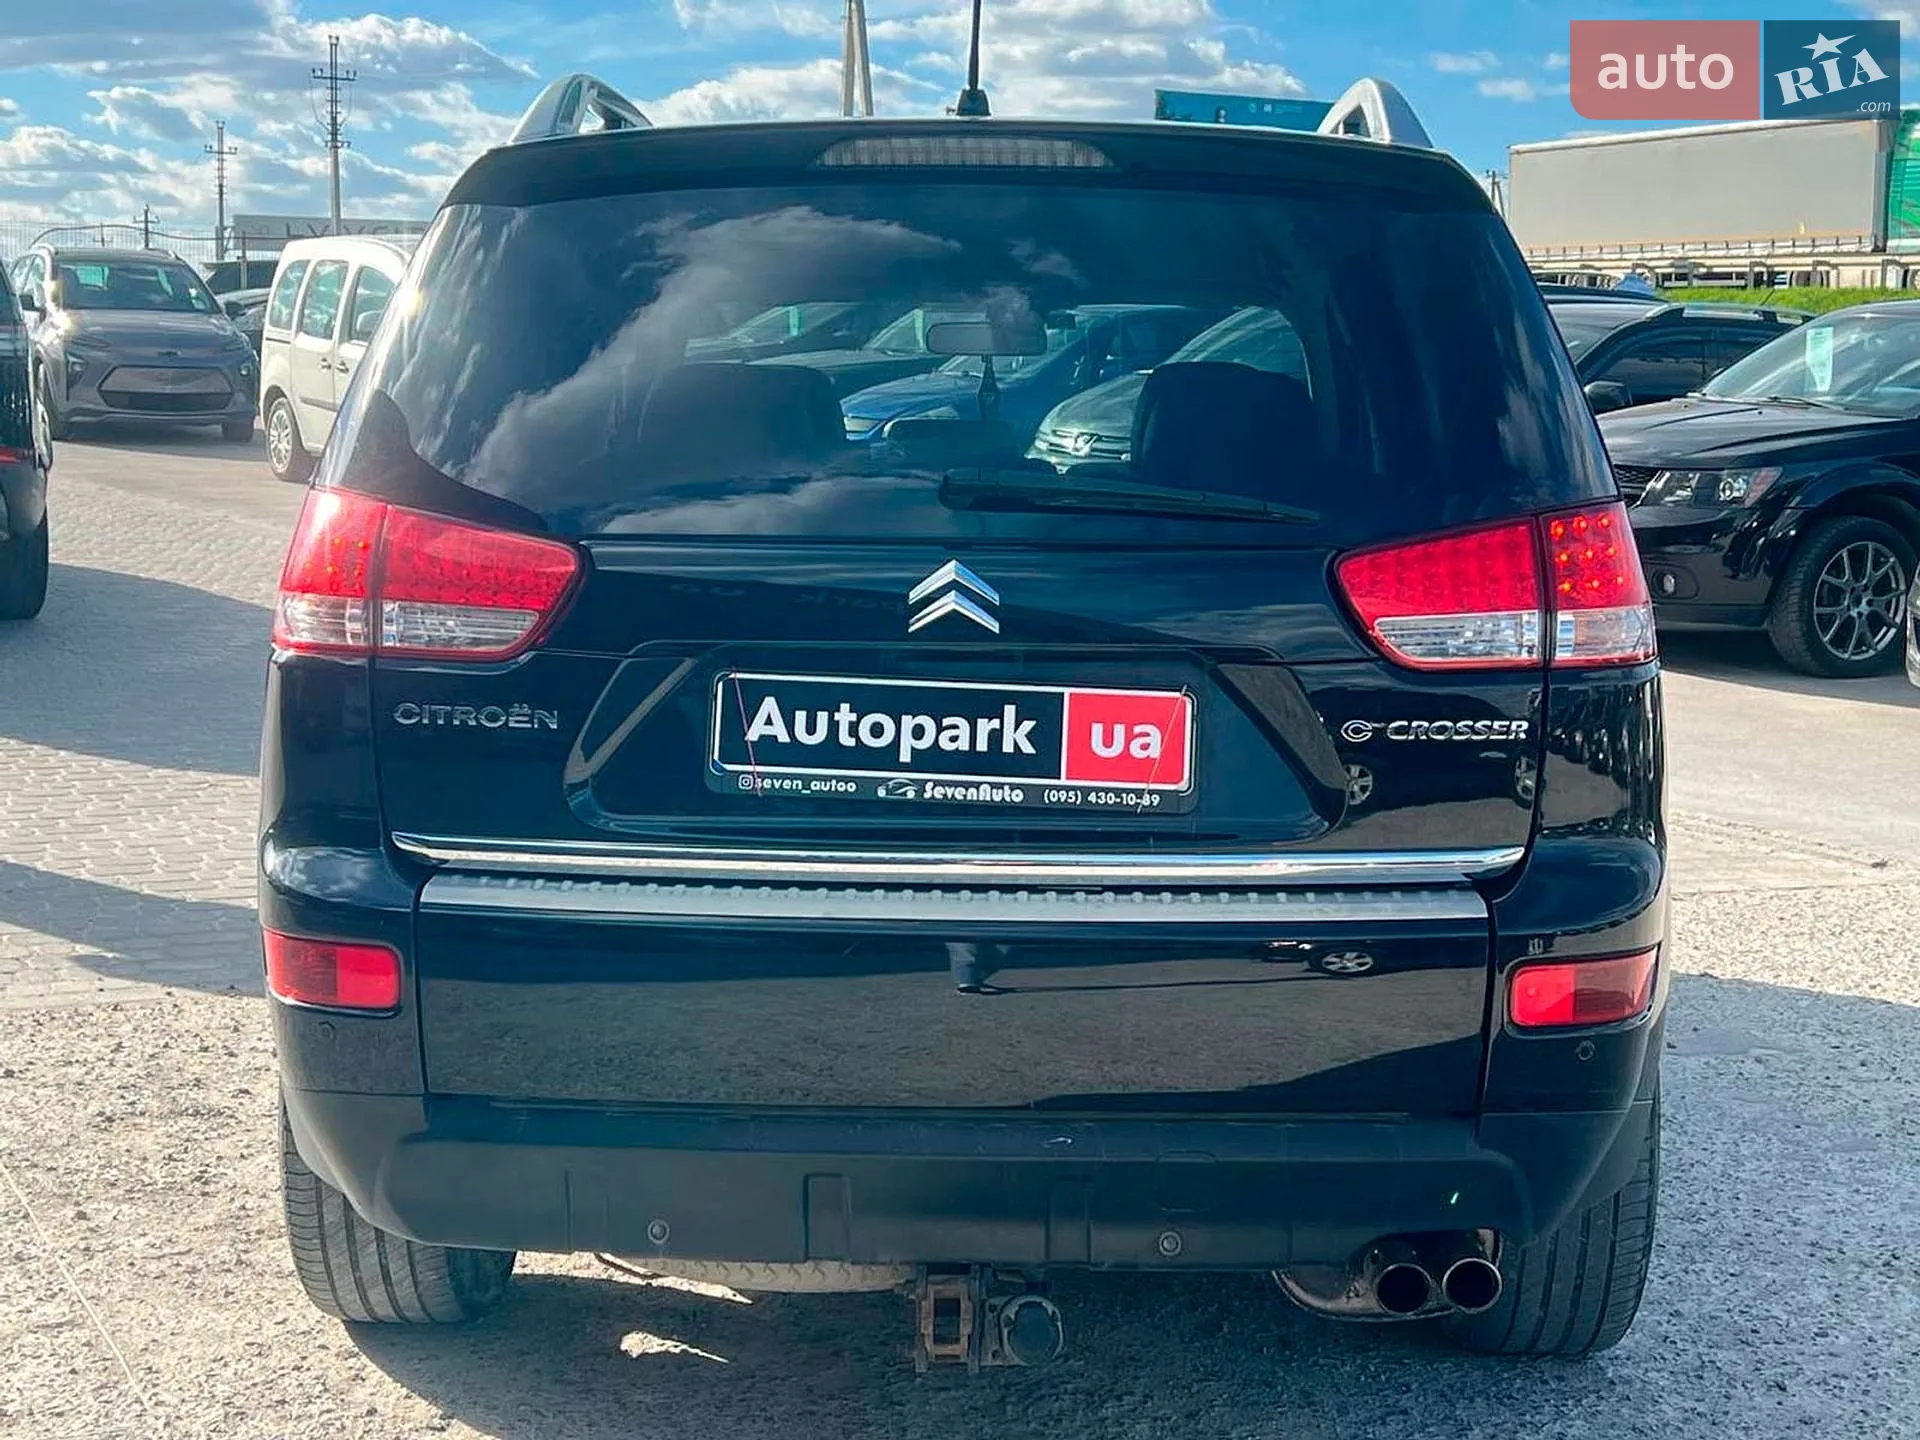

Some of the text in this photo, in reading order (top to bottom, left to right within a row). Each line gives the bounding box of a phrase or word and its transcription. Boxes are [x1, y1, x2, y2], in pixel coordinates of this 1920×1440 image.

[393, 702, 558, 729] CITROËN
[747, 696, 1162, 763] Autopark ua
[924, 781, 1024, 803] SevenAuto
[1043, 789, 1082, 804] (095)
